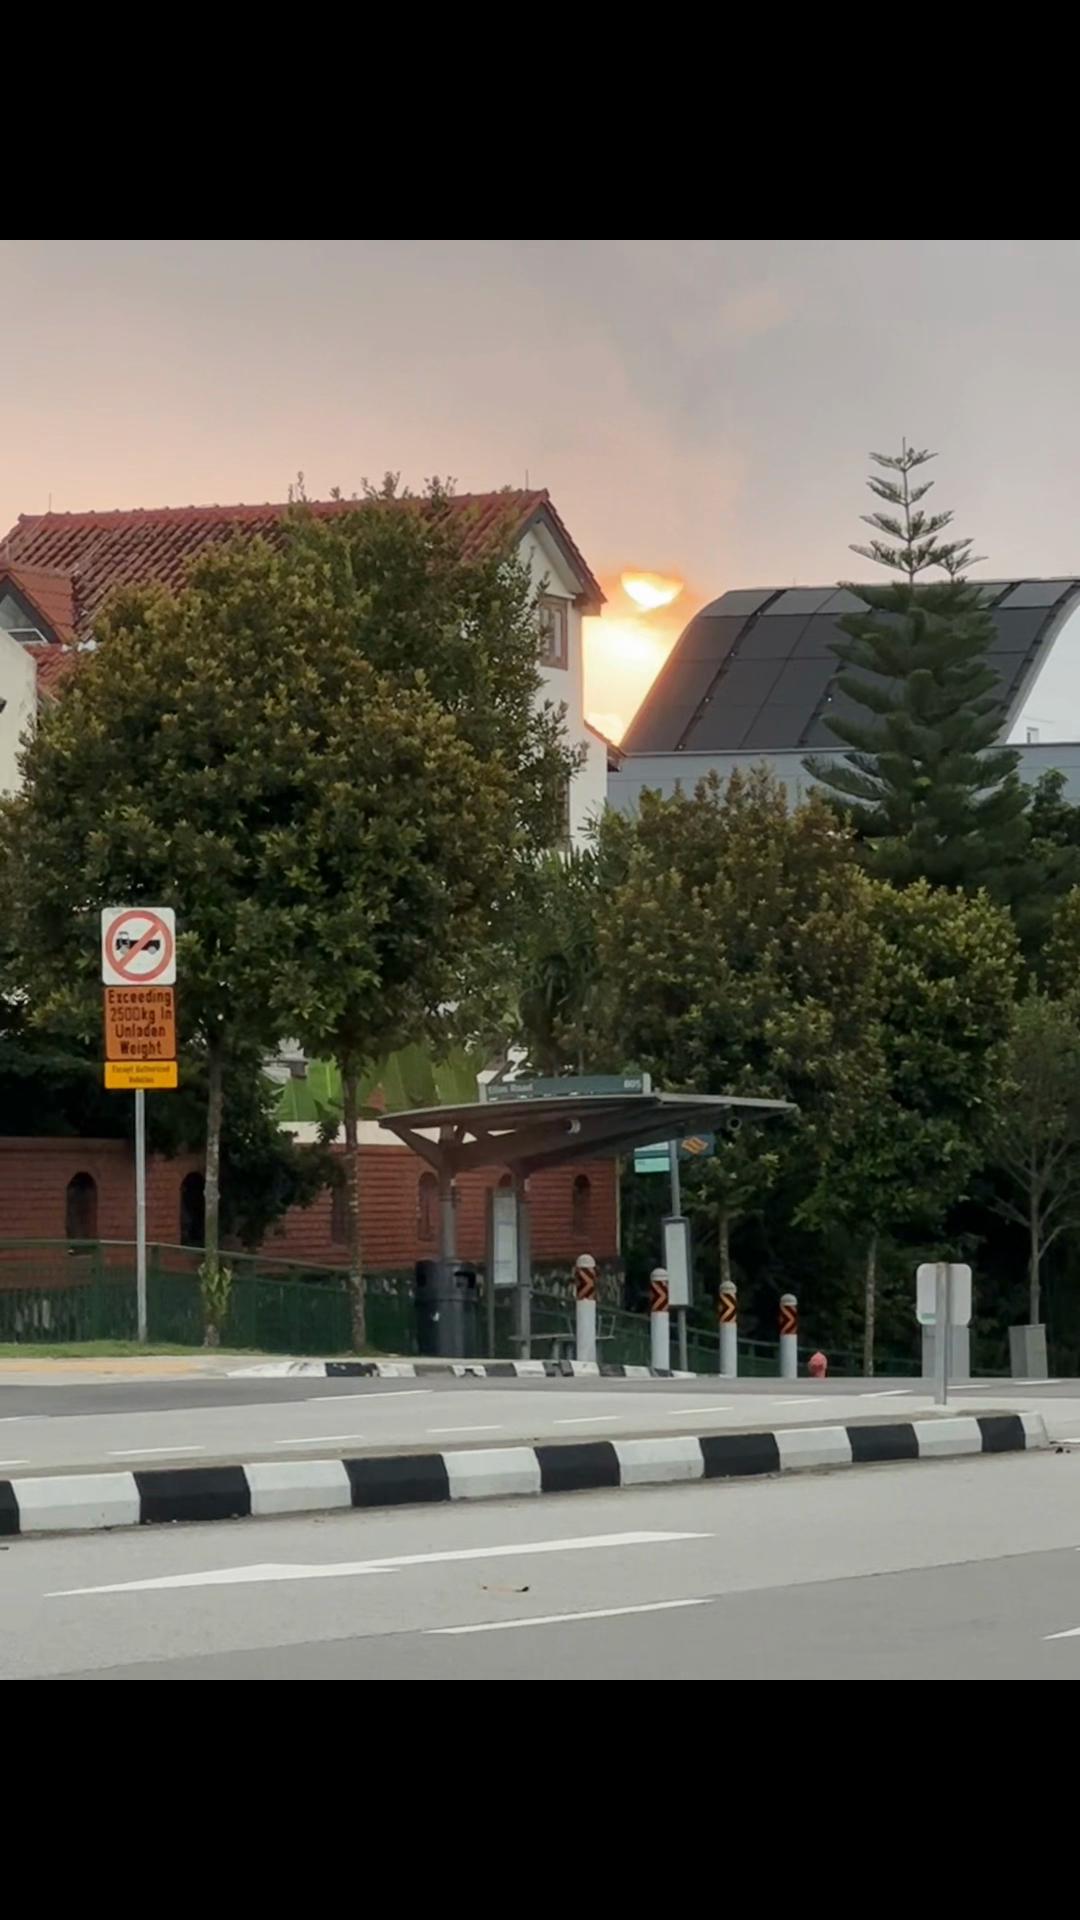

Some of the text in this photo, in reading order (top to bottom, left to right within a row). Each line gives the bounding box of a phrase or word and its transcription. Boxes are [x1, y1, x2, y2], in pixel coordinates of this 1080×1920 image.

[108, 989, 171, 1007] Exceeding
[110, 1006, 155, 1024] 2500kg
[115, 1023, 165, 1038] Unladen
[120, 1041, 162, 1059] Weight
